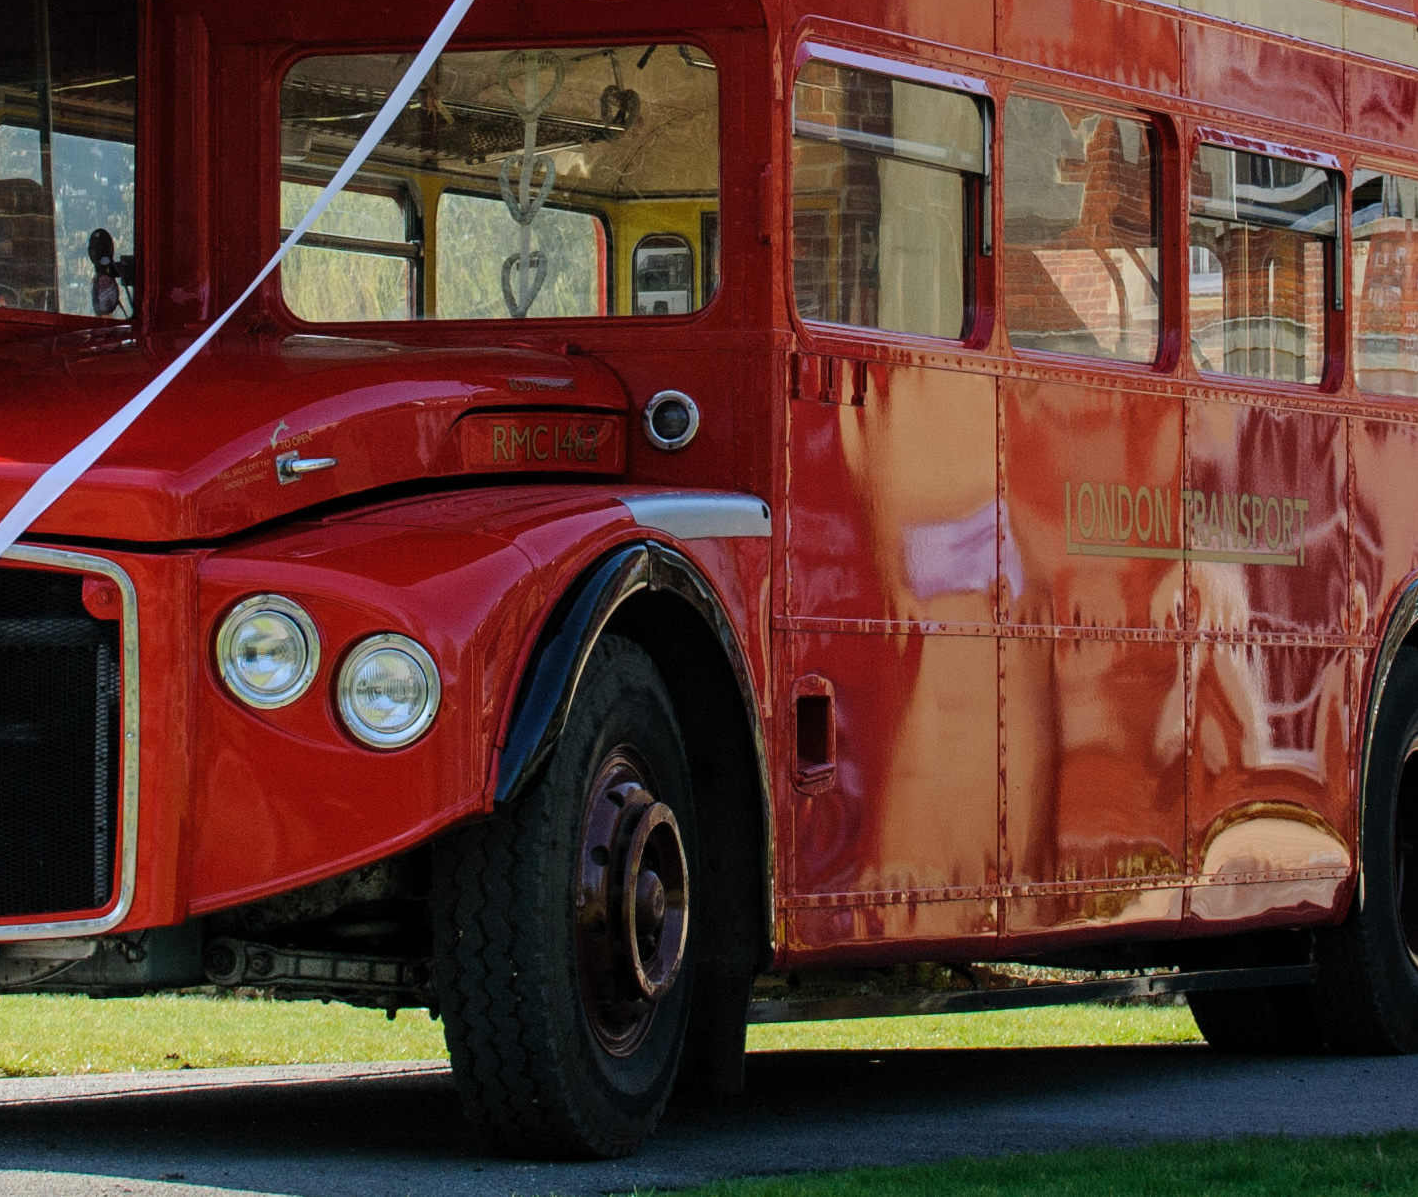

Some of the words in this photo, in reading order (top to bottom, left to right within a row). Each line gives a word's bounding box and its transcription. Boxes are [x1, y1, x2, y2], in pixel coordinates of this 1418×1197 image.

[278, 438, 291, 450] TO
[292, 432, 313, 447] OPEN
[493, 425, 548, 462] RMC
[554, 425, 598, 462] 1462
[1065, 480, 1172, 553] LONDON
[1182, 490, 1309, 566] TRANSPORT
